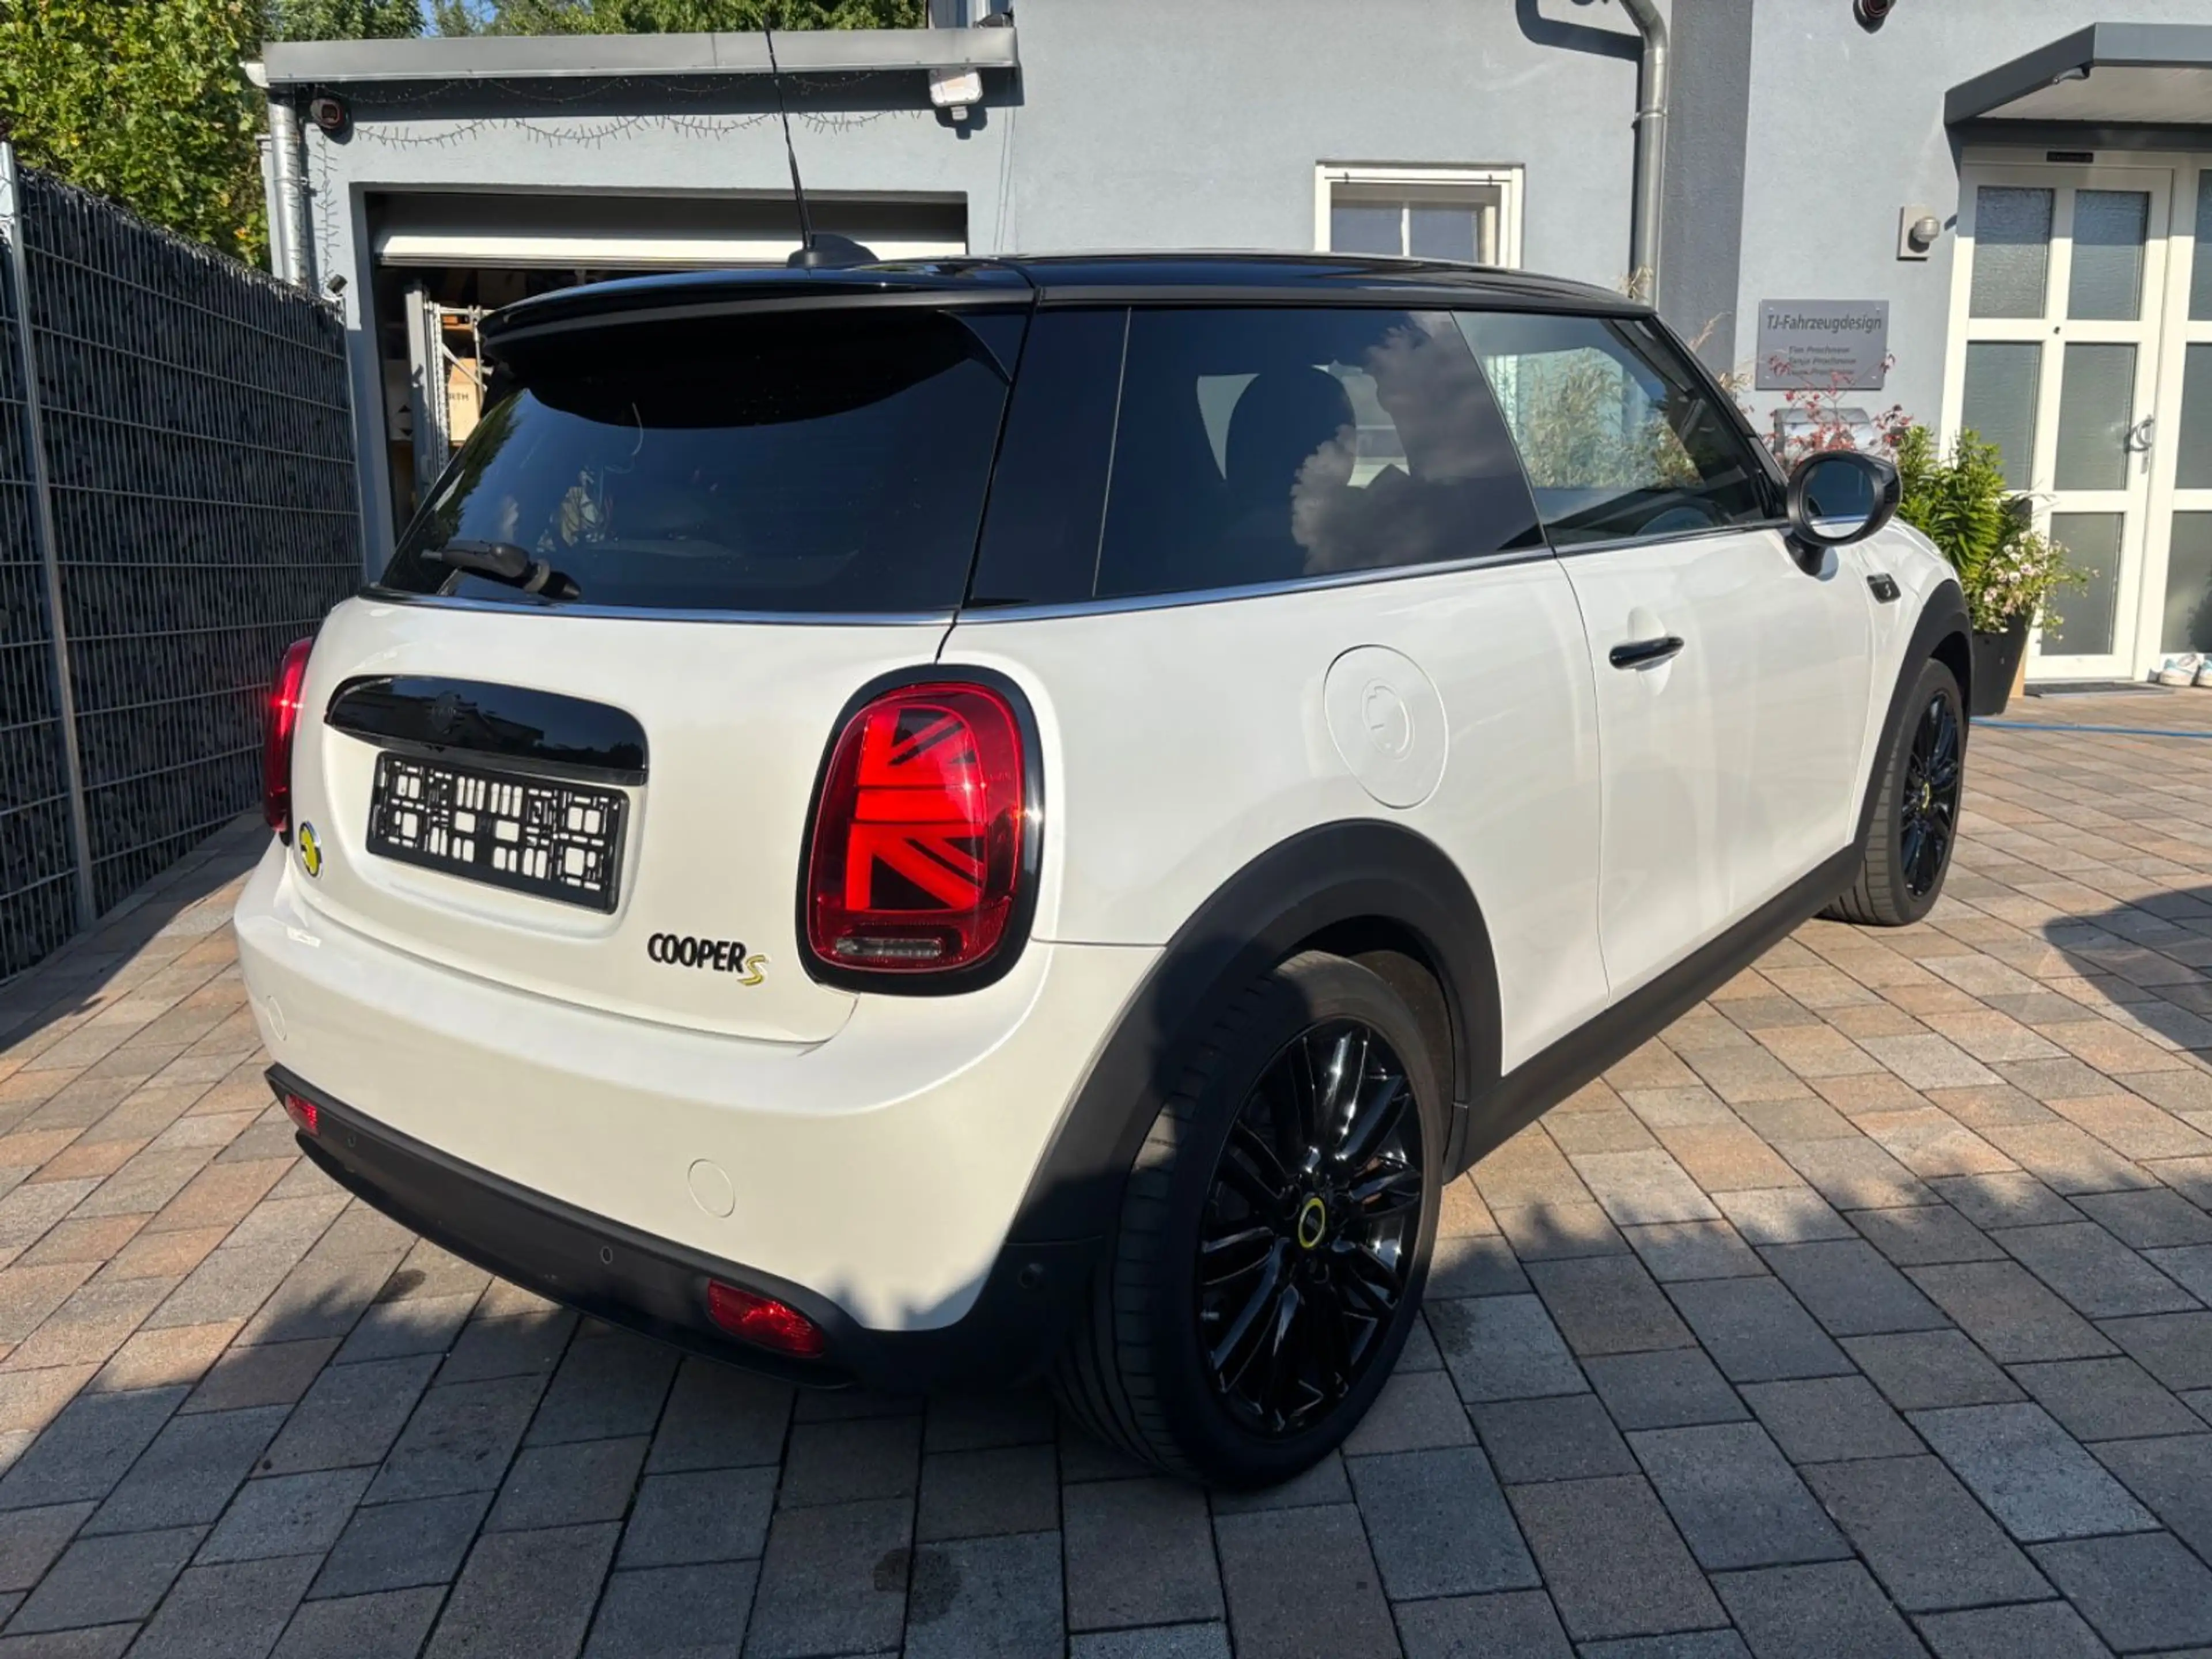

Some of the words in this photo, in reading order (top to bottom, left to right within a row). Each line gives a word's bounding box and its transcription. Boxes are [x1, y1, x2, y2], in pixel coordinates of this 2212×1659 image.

[1767, 314, 1882, 334] TJ-Fahrzeugdesign
[449, 392, 469, 401] RTH
[647, 933, 745, 974] COOPER
[737, 954, 769, 986] S
